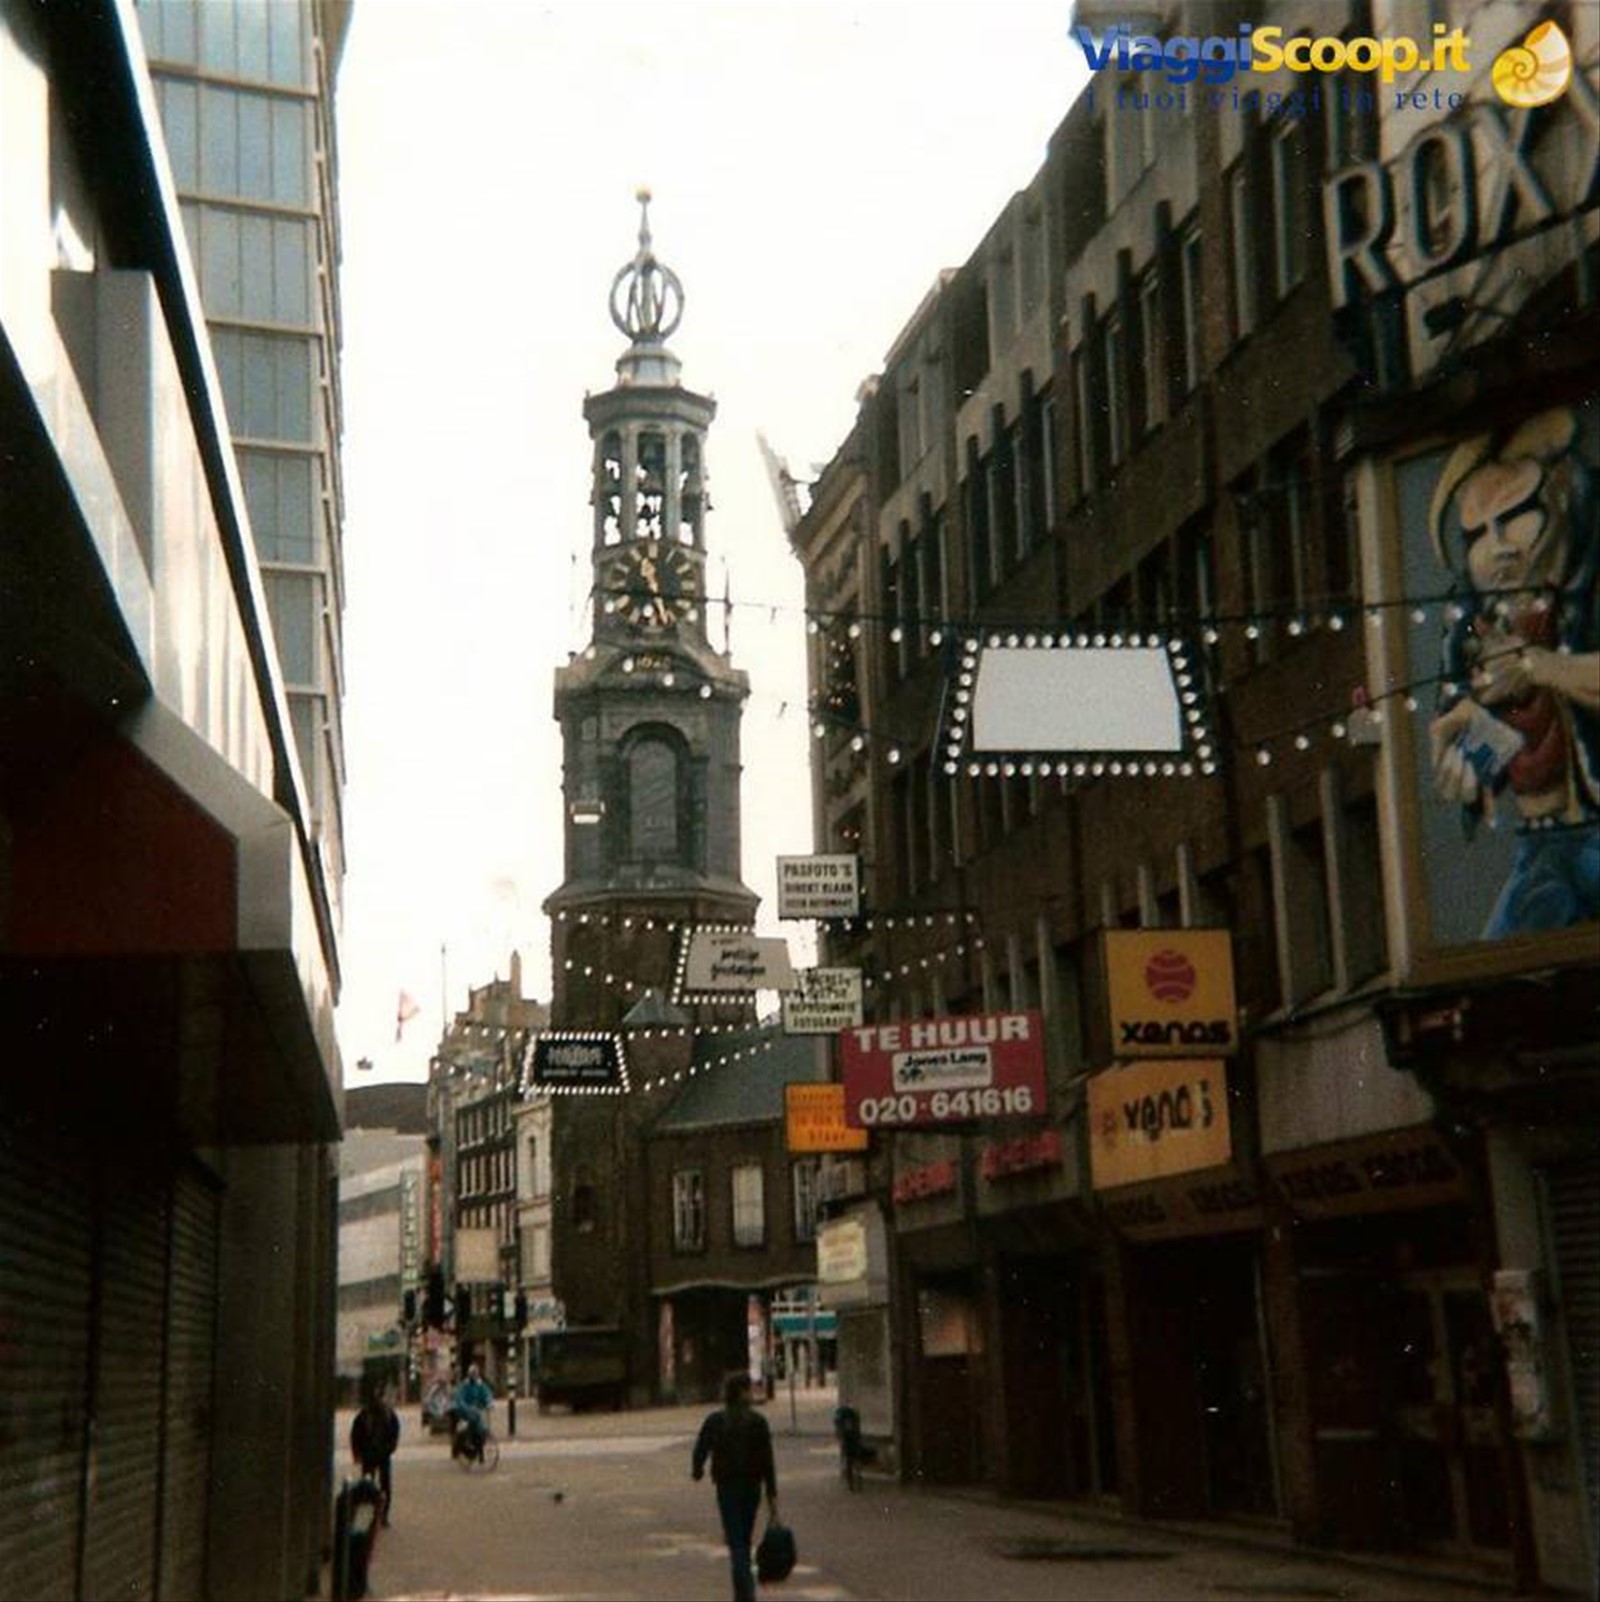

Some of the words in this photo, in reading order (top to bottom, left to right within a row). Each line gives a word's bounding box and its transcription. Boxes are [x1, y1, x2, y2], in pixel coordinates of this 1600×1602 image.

[853, 1026, 902, 1053] TE
[910, 1015, 1030, 1048] HUUR
[1120, 1021, 1231, 1045] xenos
[903, 1052, 948, 1068] Jones
[950, 1051, 987, 1066] Lang
